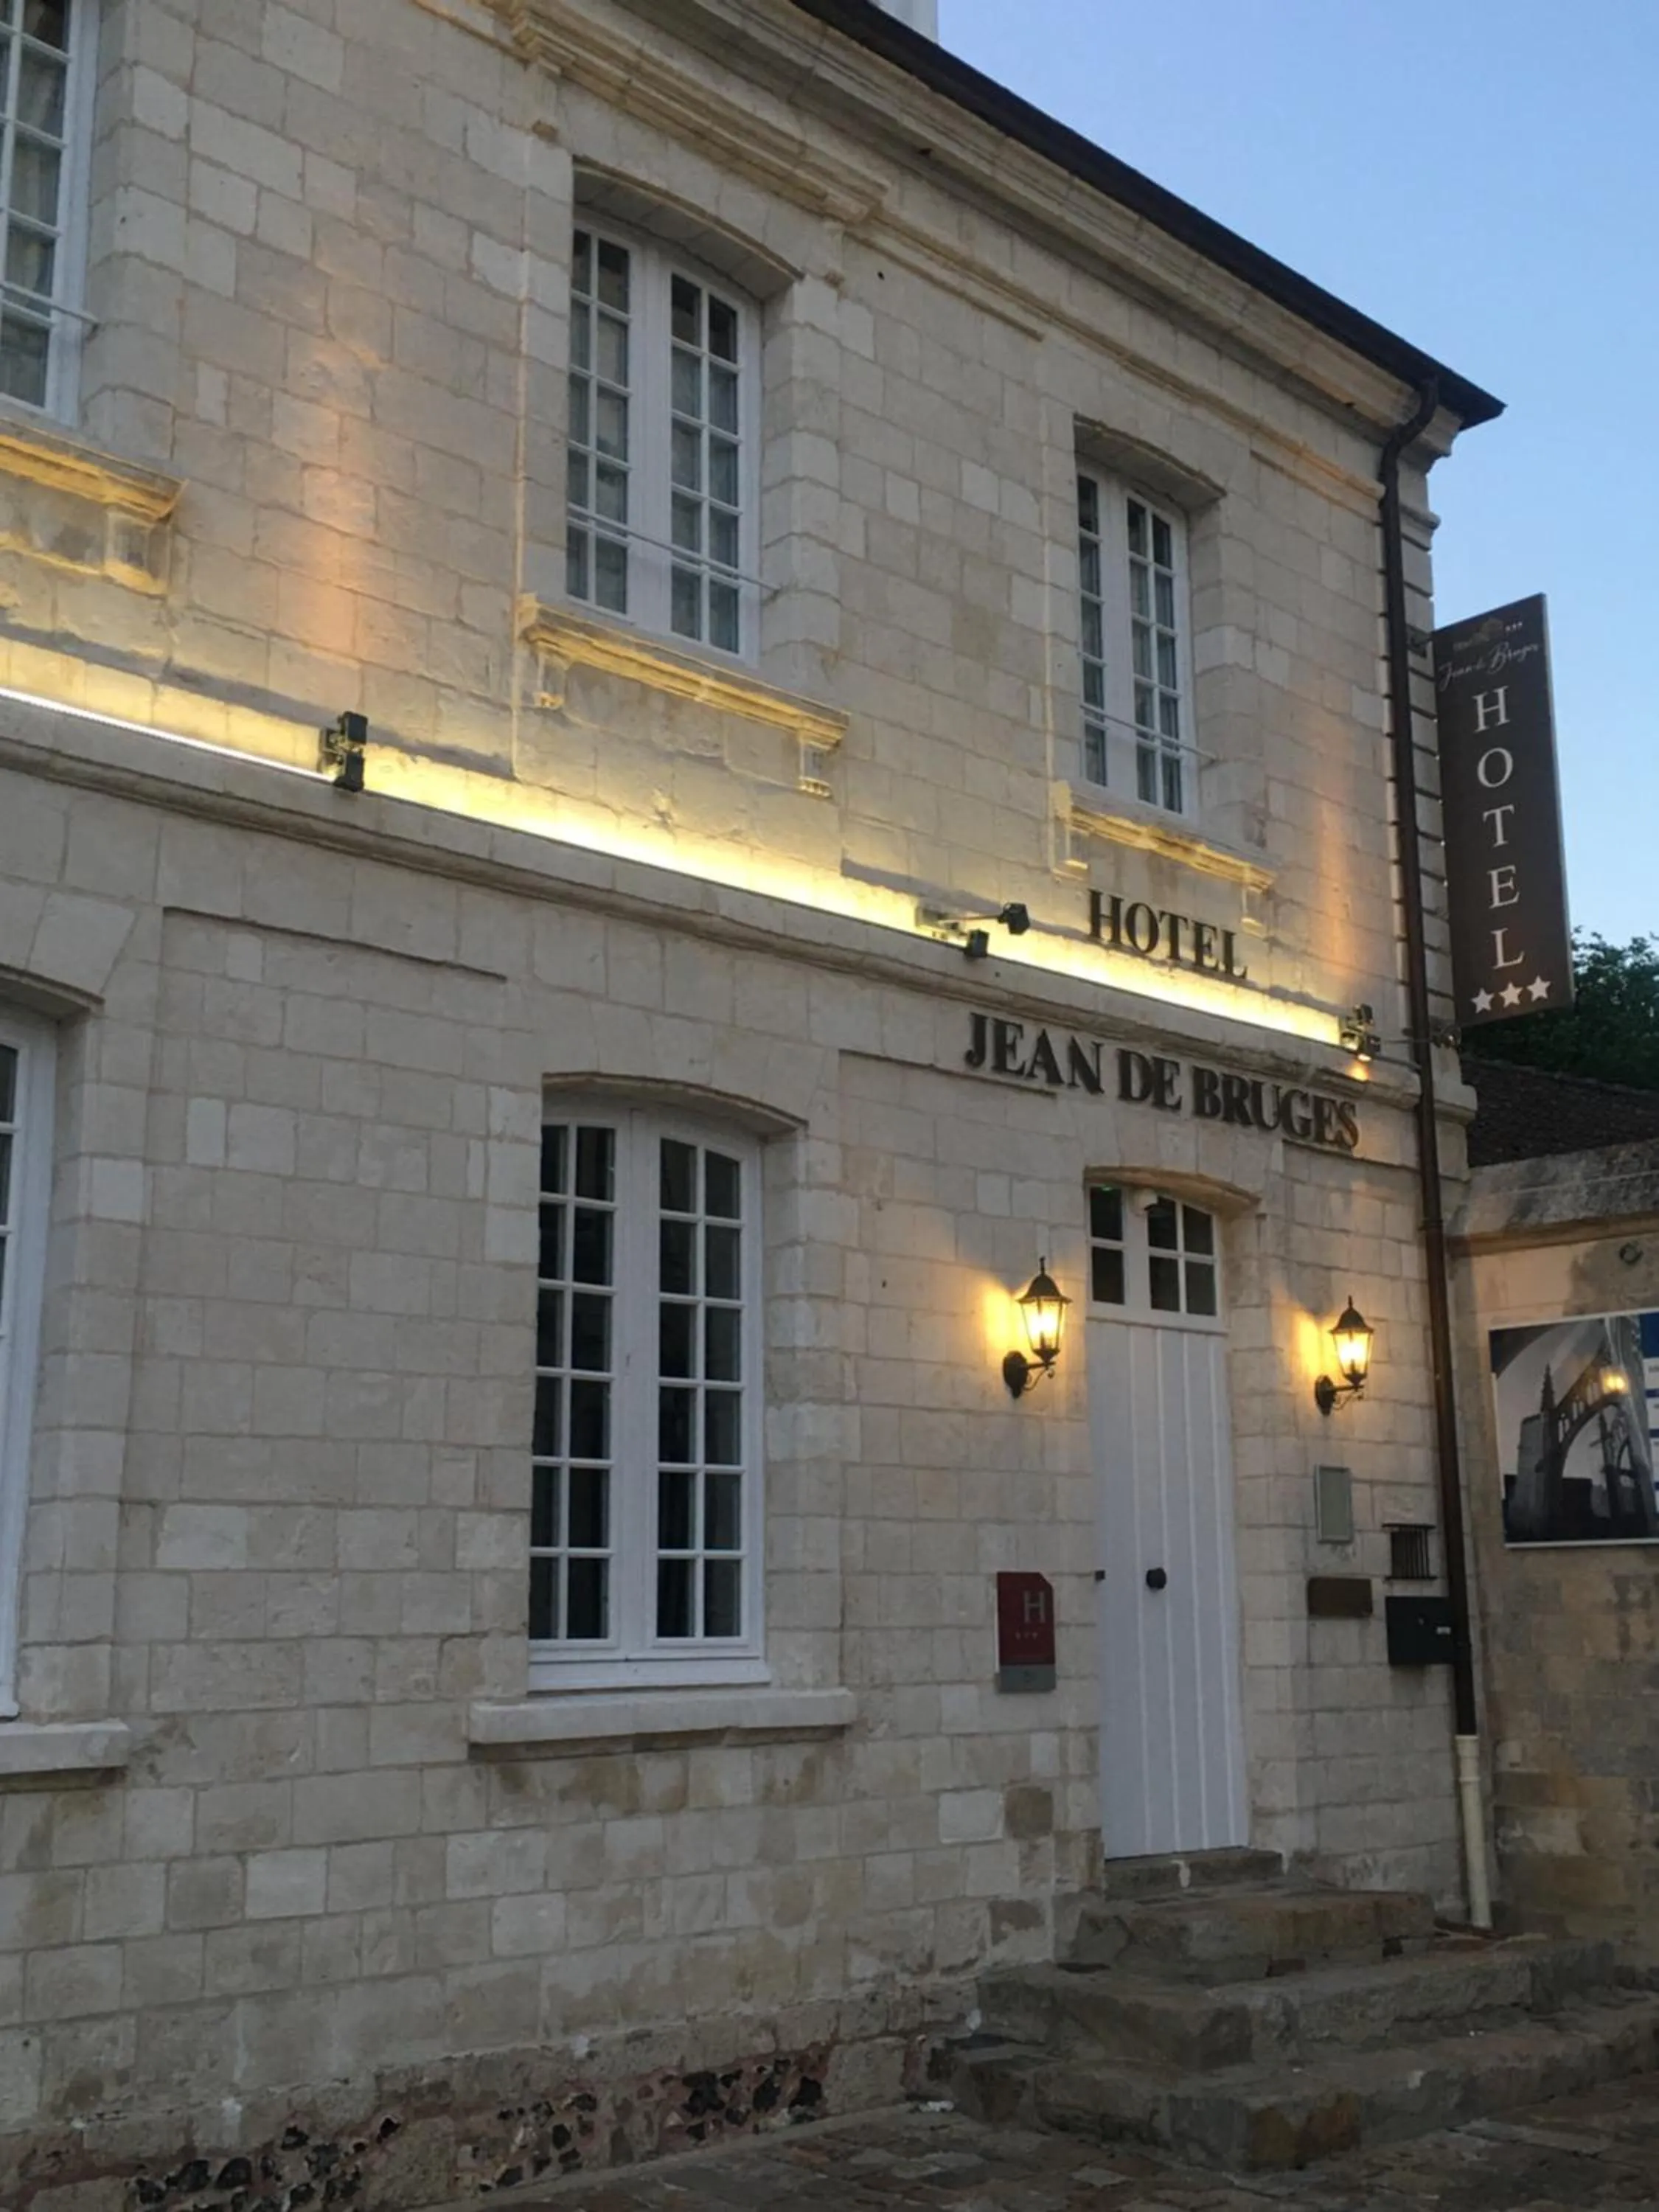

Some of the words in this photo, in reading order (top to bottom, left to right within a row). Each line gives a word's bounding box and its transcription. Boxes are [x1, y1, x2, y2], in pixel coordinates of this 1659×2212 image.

[1472, 686, 1523, 970] HOTEL
[1088, 889, 1248, 978] HOTEL
[964, 1012, 1105, 1096] JEAN
[1116, 1048, 1183, 1111] DE
[1192, 1065, 1360, 1149] BRUGES
